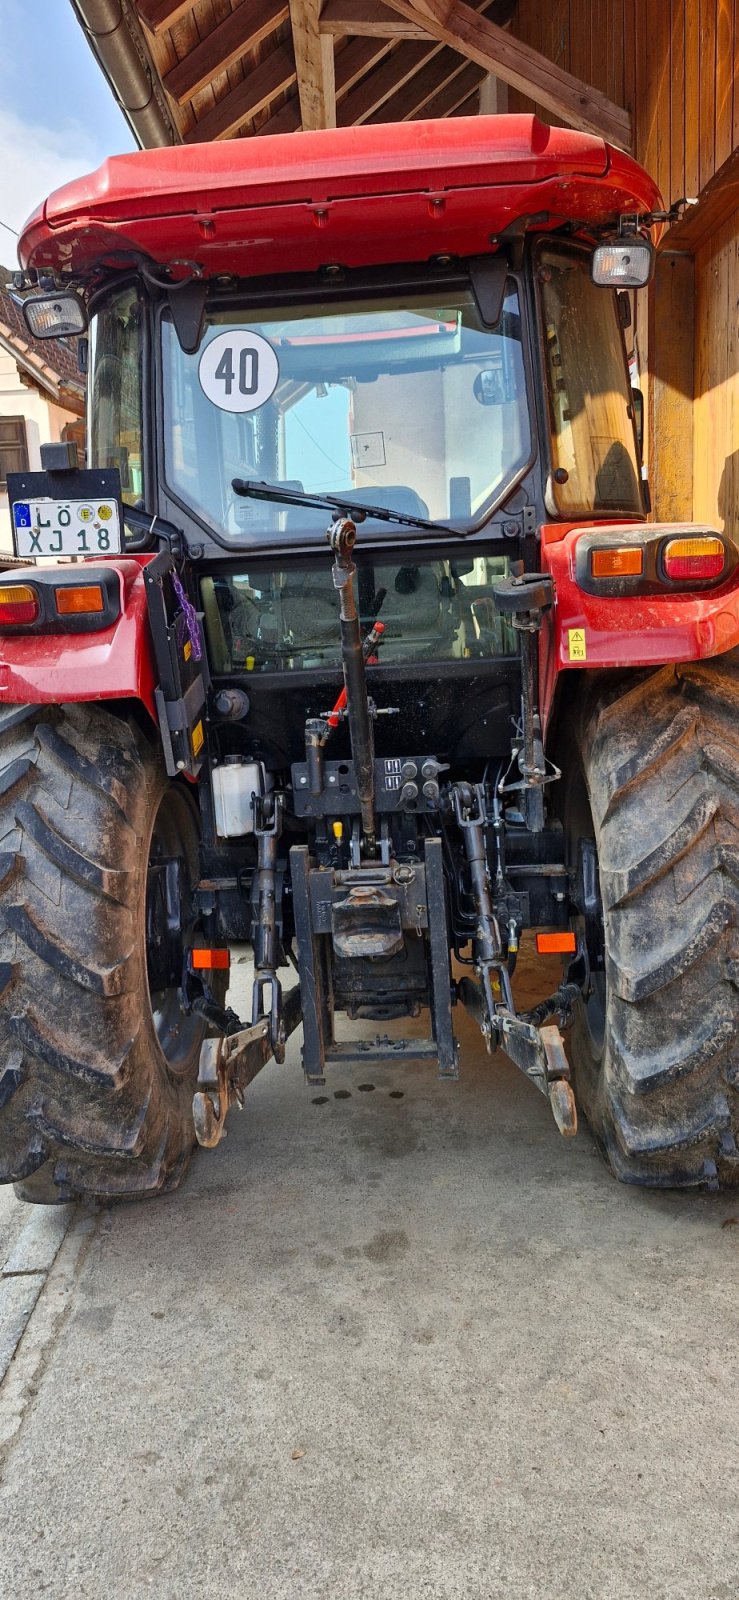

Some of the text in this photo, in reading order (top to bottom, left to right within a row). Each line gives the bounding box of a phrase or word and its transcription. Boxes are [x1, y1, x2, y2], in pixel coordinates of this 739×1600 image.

[214, 347, 259, 395] 40
[20, 518, 27, 526] D
[36, 504, 71, 528] LÖ
[29, 528, 110, 553] XJ 18
